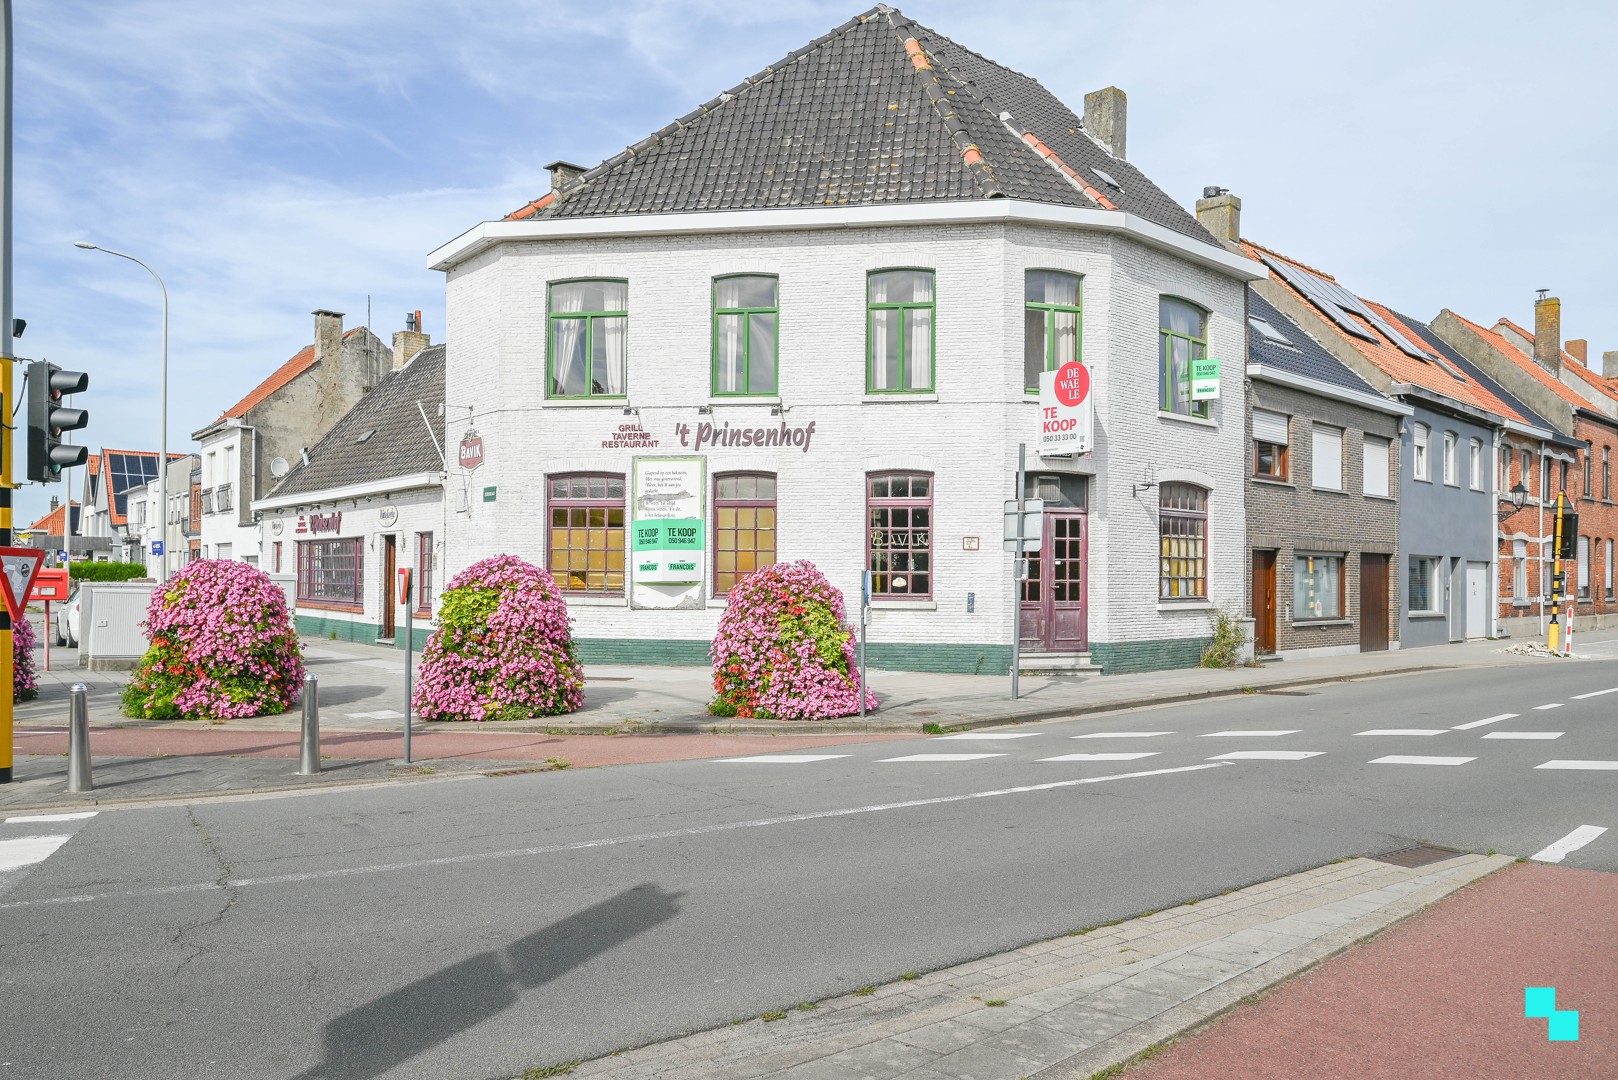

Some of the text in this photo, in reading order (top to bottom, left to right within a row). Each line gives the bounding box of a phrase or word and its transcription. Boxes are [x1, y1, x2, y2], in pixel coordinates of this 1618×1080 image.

[1067, 368, 1079, 378] DE
[1060, 379, 1080, 389] WAE
[1069, 389, 1080, 400] LE
[1043, 407, 1058, 419] TE
[618, 424, 643, 432] GRILL
[1043, 418, 1077, 433] KOOP
[612, 432, 651, 441] TAVERNE
[675, 420, 816, 453] 't Prinsenhof
[601, 440, 660, 448] RESTAURANT
[460, 444, 482, 459] BAVIK
[638, 528, 659, 538] TE KOOP
[668, 528, 697, 537] TE KOOP
[669, 563, 695, 571] FRANCOIS
